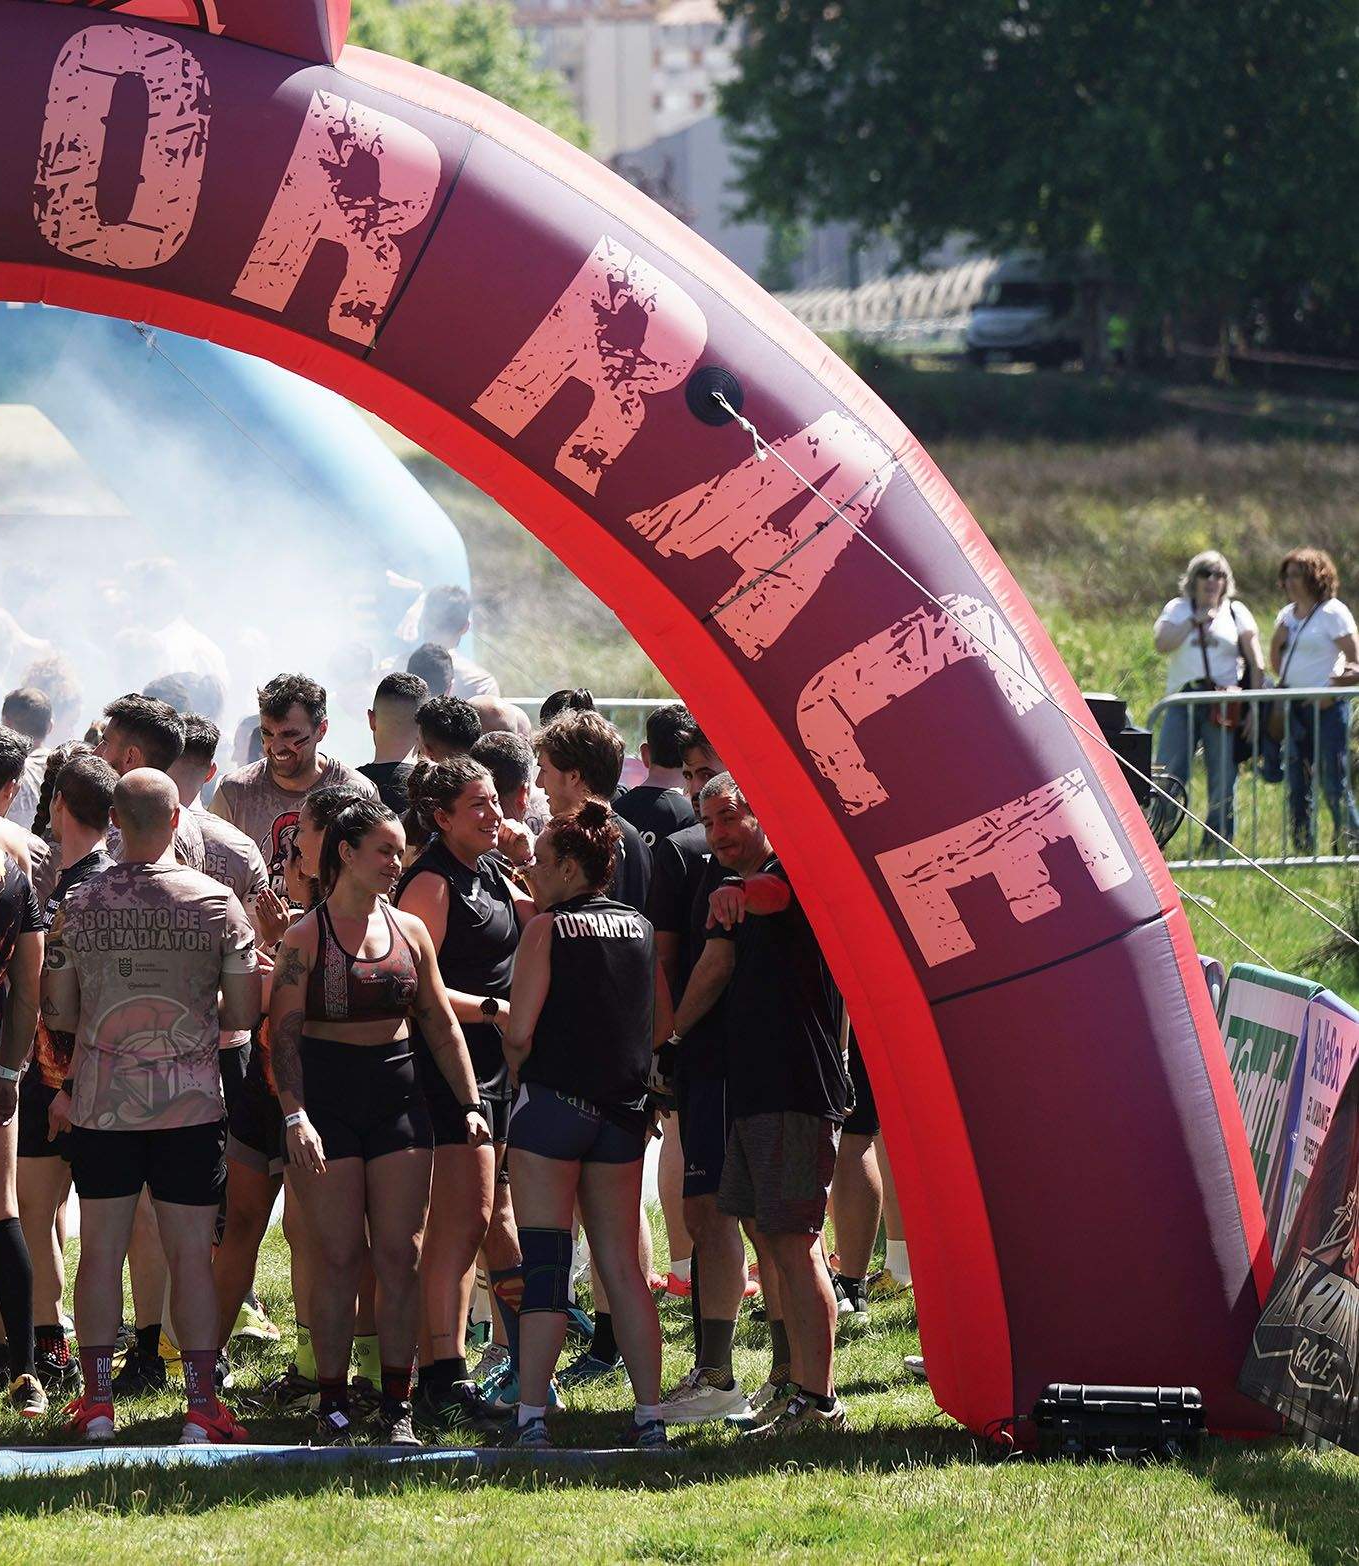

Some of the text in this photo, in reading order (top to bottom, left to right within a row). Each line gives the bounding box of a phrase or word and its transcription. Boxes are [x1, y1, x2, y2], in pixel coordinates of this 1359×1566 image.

[470, 234, 1133, 967] RACE
[82, 908, 141, 931] BORN
[141, 908, 171, 930] TO
[174, 909, 201, 930] BE
[553, 912, 644, 939] TURRANTES
[95, 929, 212, 952] GLADIATOR
[1292, 1337, 1340, 1381] RACE
